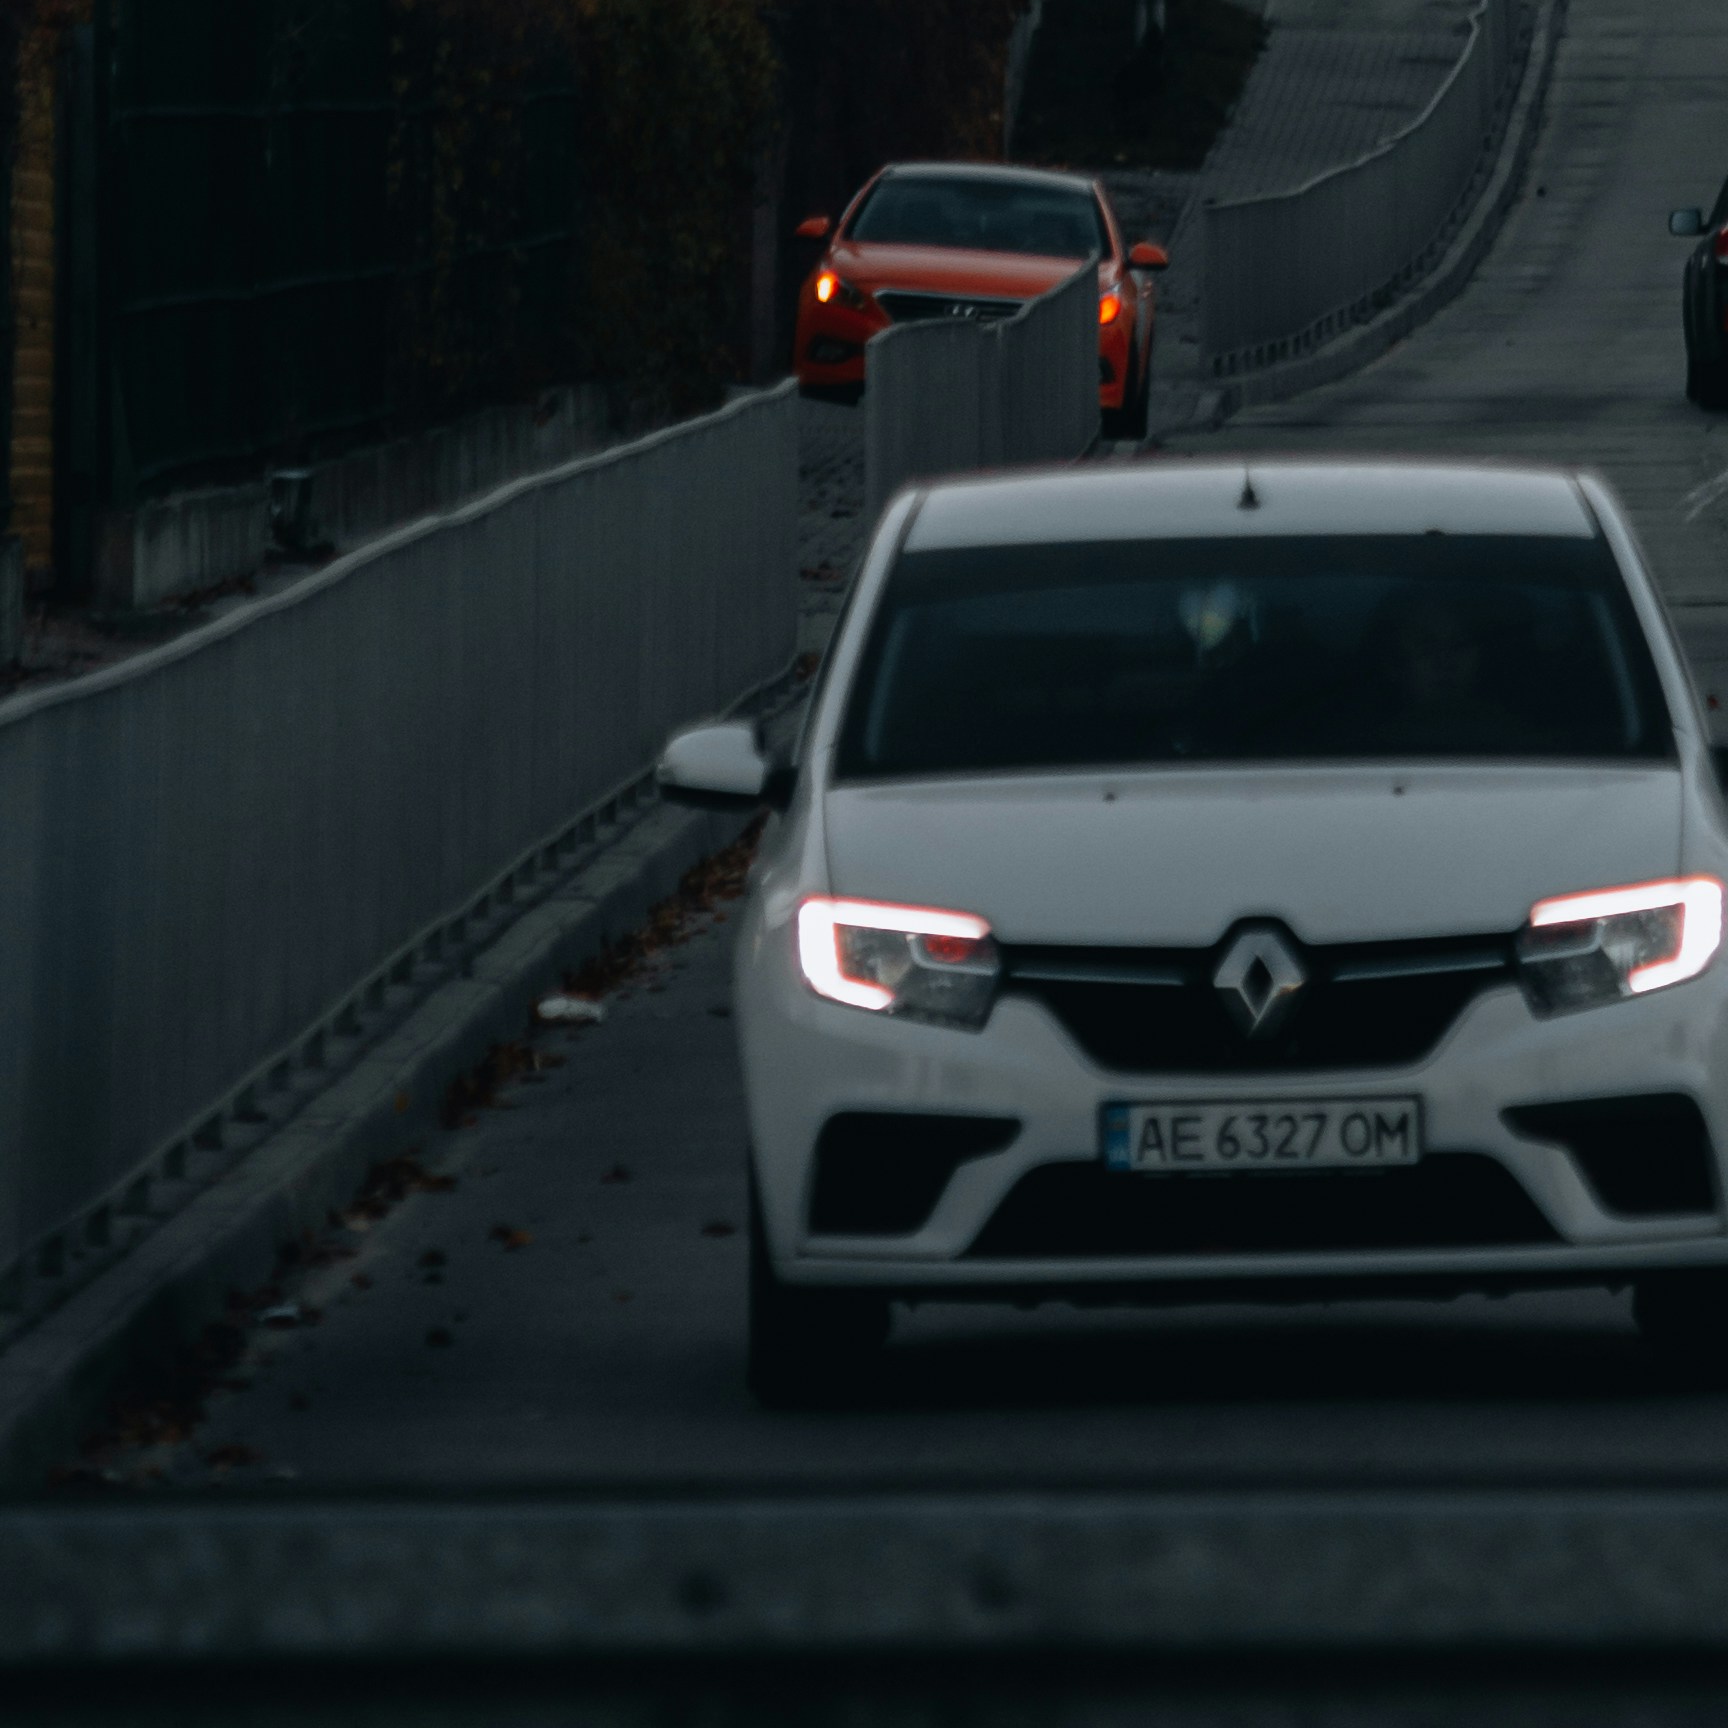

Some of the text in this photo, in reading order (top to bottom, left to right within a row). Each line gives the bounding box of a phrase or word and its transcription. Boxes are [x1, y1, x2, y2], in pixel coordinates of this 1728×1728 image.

[1137, 1111, 1410, 1162] AE 6327 OM
